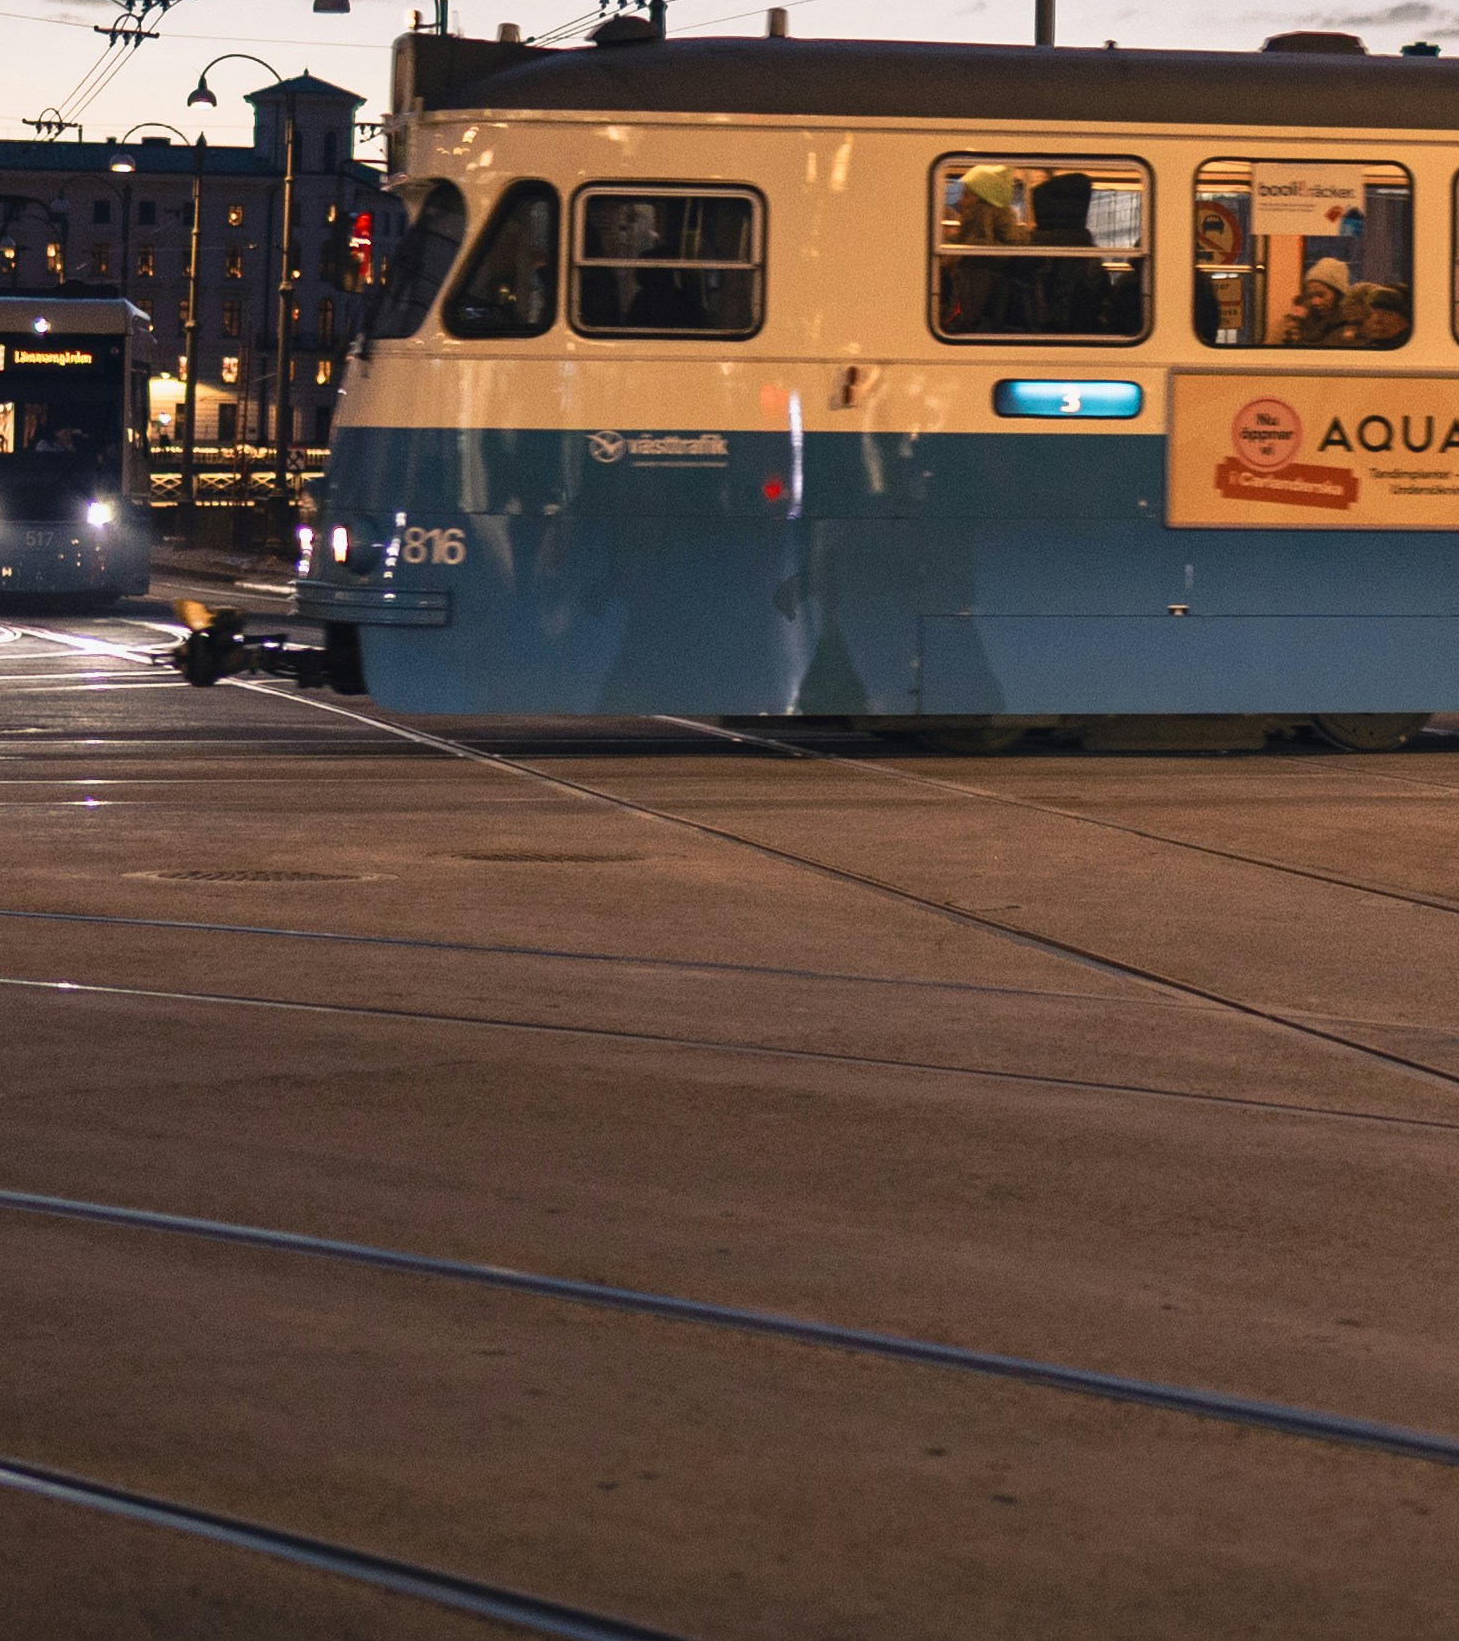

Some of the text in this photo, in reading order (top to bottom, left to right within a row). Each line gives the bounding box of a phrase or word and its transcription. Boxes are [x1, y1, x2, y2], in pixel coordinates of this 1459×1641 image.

[1059, 384, 1081, 413] 3
[25, 530, 54, 546] 517
[402, 526, 466, 565] 816
